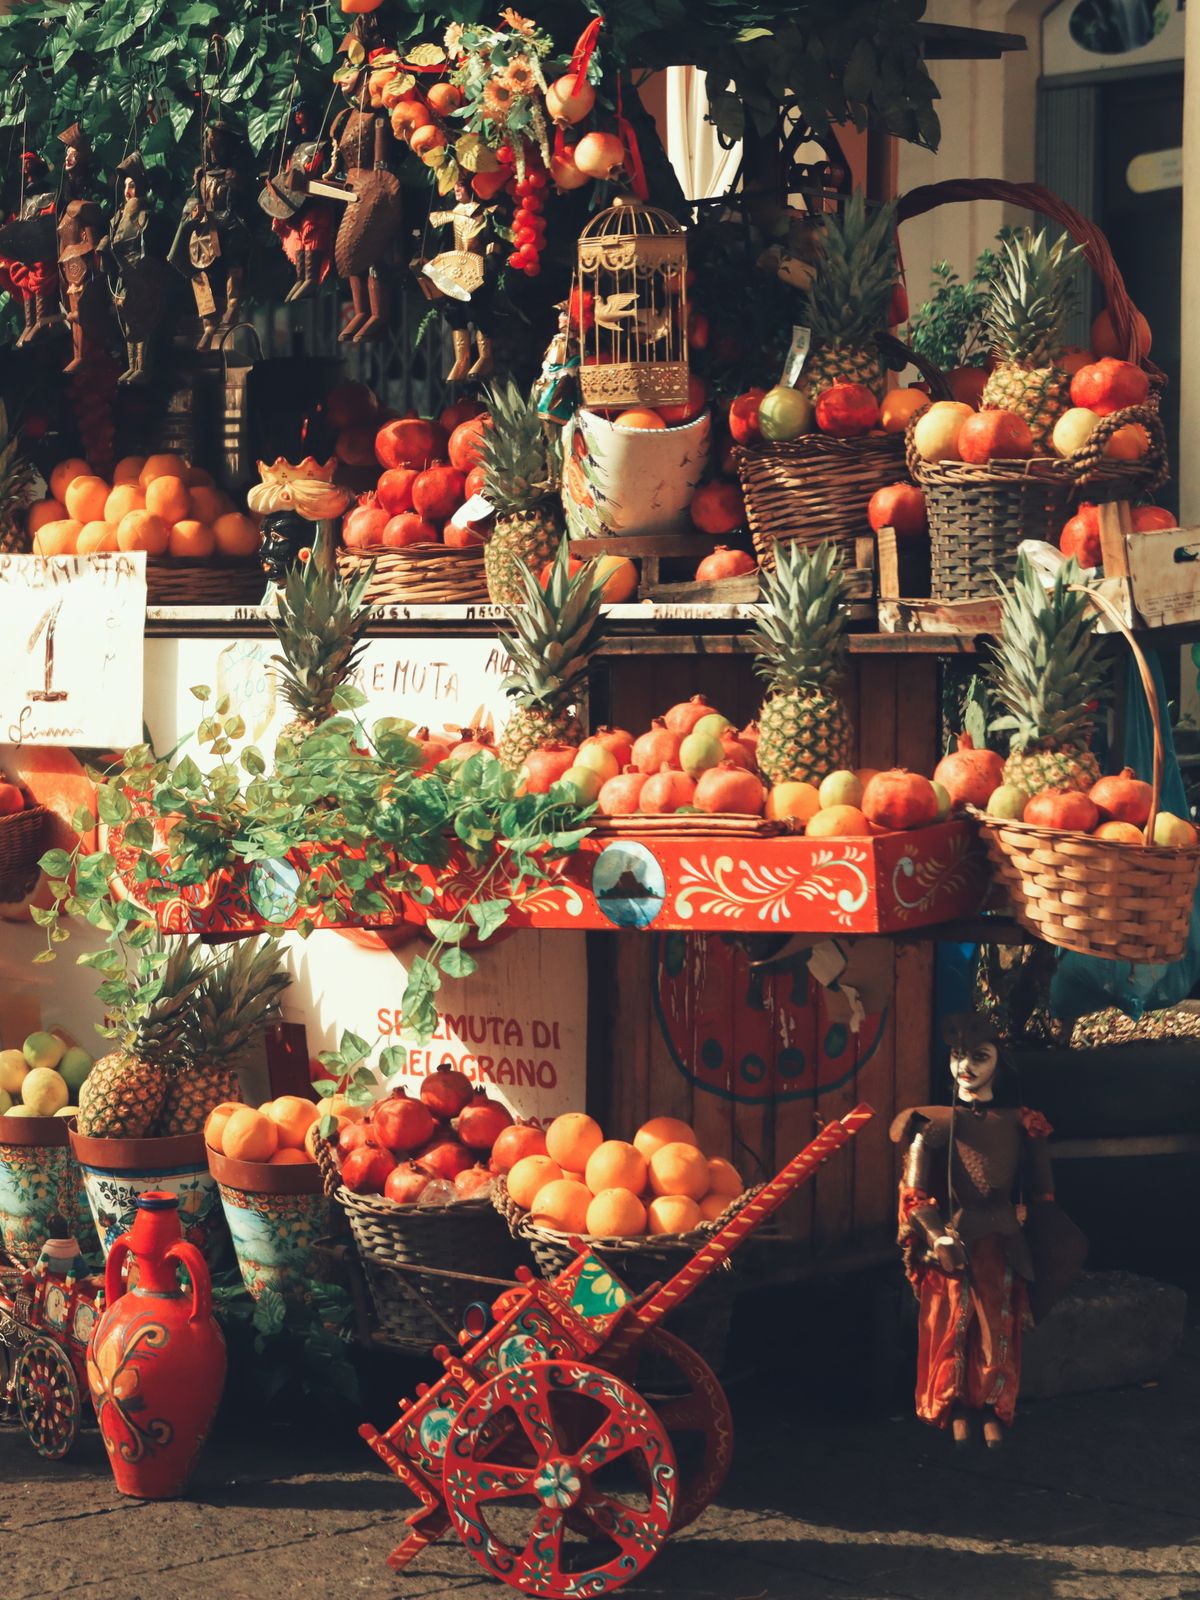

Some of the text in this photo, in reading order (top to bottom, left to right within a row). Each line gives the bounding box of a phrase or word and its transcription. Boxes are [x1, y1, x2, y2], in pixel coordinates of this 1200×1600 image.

[26, 597, 70, 702] 1
[350, 658, 460, 703] REMUTA
[377, 1008, 561, 1050] SPEMUTA DI
